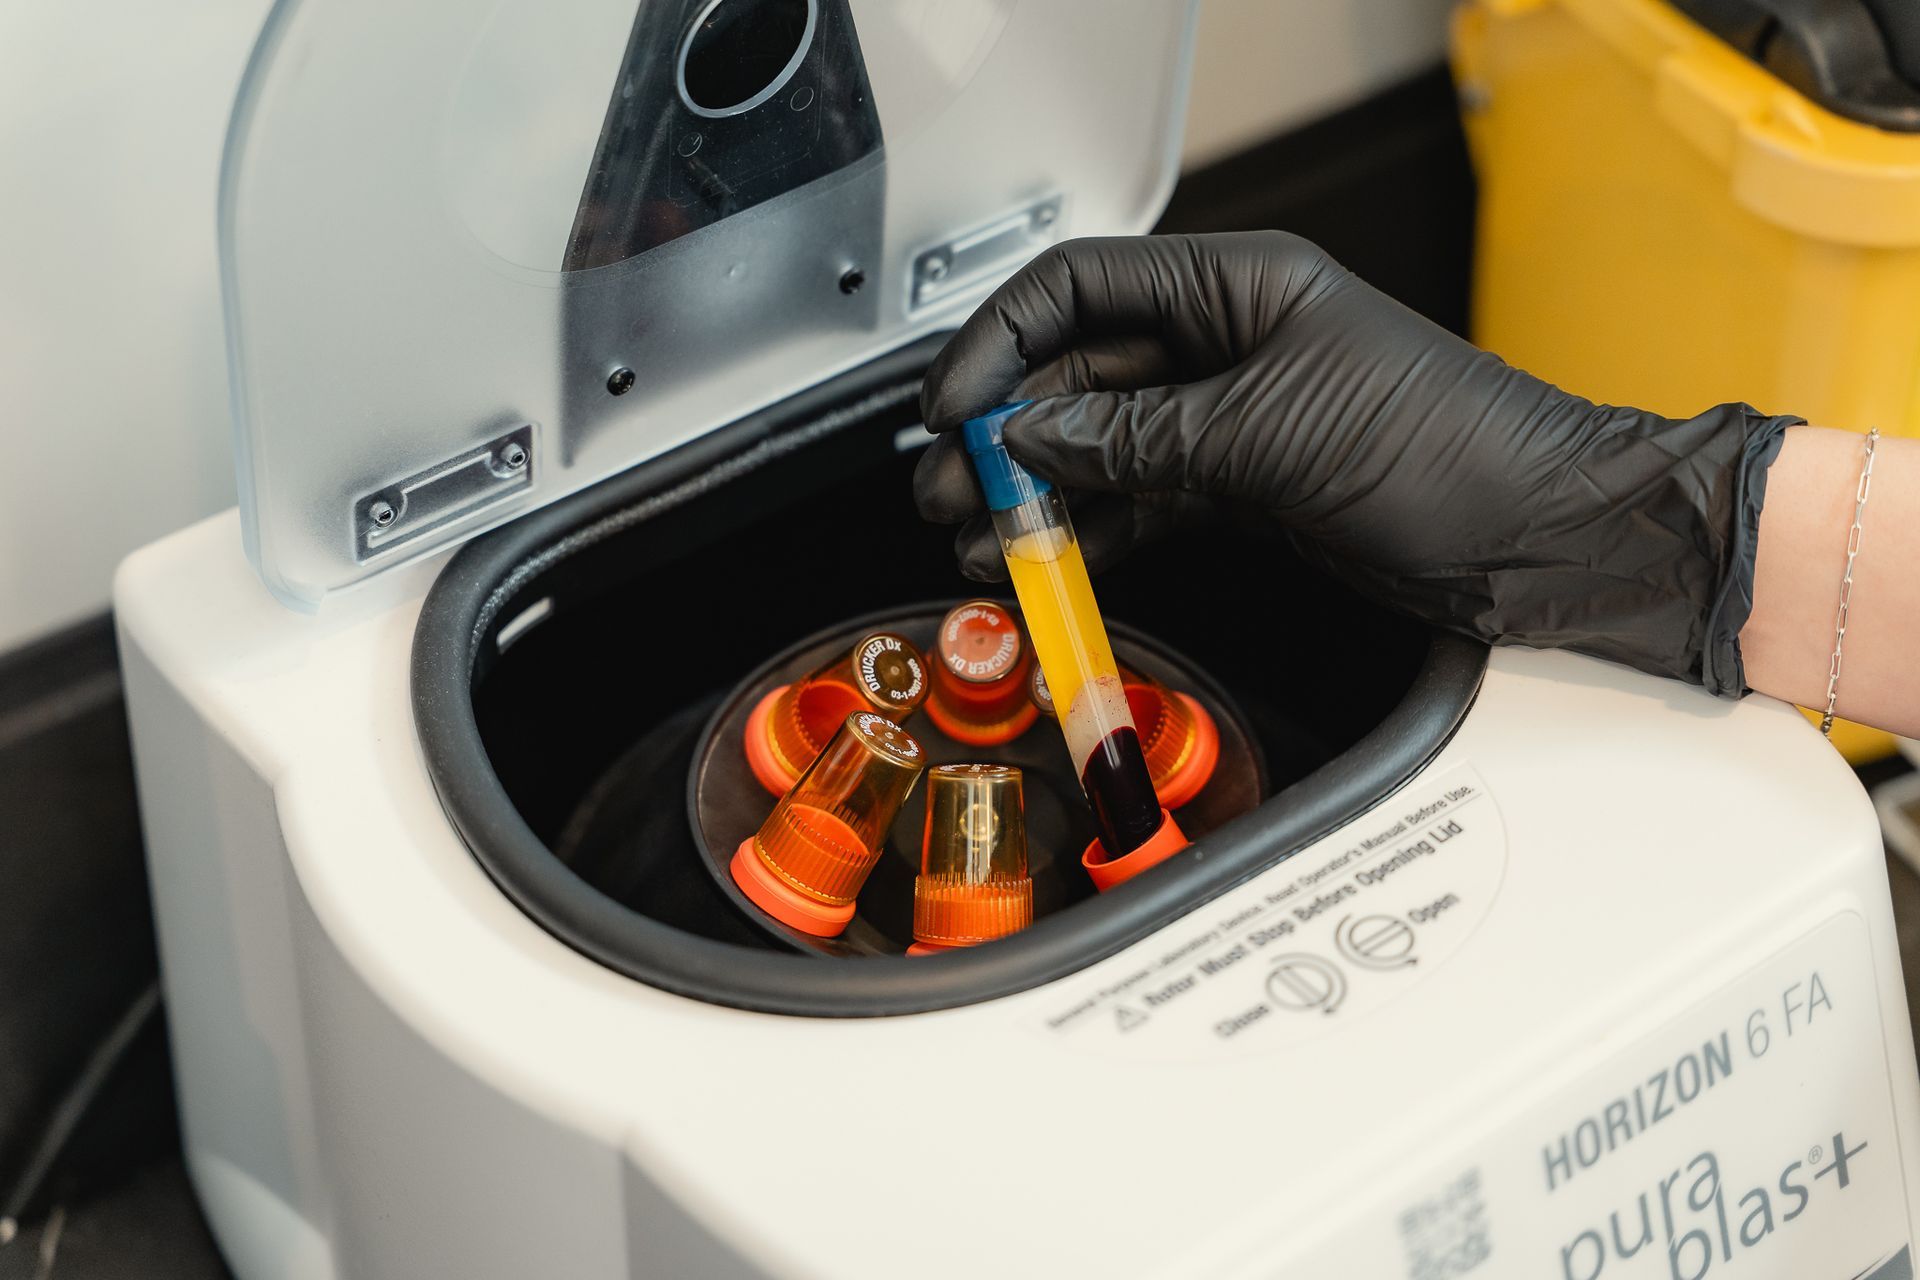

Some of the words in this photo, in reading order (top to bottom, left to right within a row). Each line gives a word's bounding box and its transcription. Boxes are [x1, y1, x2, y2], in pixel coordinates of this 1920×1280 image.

[863, 639, 886, 692] DRUCKER
[886, 638, 901, 652] DX
[950, 653, 967, 672] DX
[968, 633, 1015, 675] DRUCKER
[1299, 848, 1362, 886] Operator's
[1361, 823, 1407, 851] Manual
[1405, 800, 1448, 825] Before
[1445, 785, 1474, 802] Use.
[1198, 943, 1248, 976] Must
[1248, 919, 1296, 947] Stop
[1292, 884, 1358, 922] Before
[1355, 839, 1436, 887] Opening
[1429, 820, 1463, 843] Lid
[1408, 892, 1460, 923] Open
[1541, 1031, 1734, 1192] HORIZON
[1745, 1008, 1770, 1059] 6
[1782, 971, 1833, 1037] FA
[1559, 1150, 1720, 1280] pura
